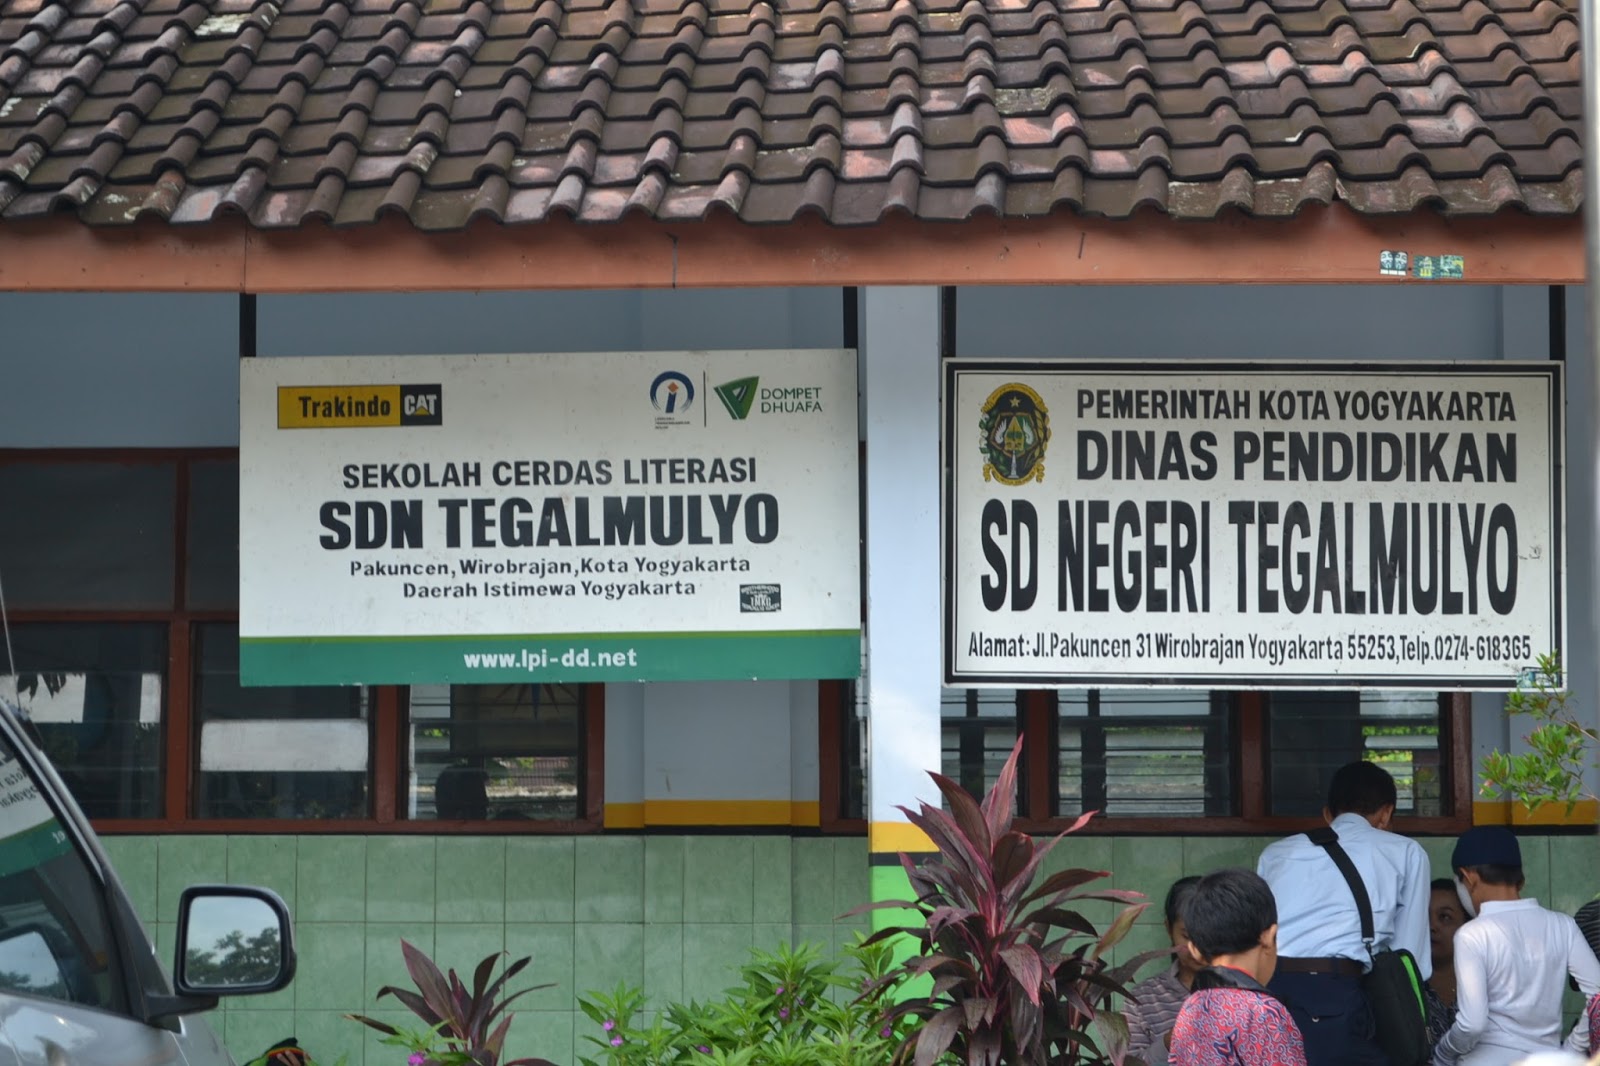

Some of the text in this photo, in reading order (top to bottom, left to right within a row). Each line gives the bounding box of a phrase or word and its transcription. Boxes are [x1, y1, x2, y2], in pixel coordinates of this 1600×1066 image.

[404, 394, 438, 416] CAT
[761, 387, 822, 400] DOMPET
[1077, 389, 1251, 419] PEMERINTAH
[1258, 390, 1330, 420] KOTA
[1334, 390, 1517, 421] YOGYAKARTA
[299, 395, 391, 418] Trakindo
[761, 400, 823, 414] DHUAFA
[1077, 429, 1217, 480] DINAS
[1233, 430, 1517, 483] PENDIDIKAN
[343, 457, 756, 489] SEKOLAH CERDAS LITERASI
[319, 493, 779, 550] SDN TEGALMULYO
[350, 560, 456, 579] Pakuncen,
[634, 556, 750, 577] Yogyakarta
[980, 498, 1516, 616] SD NEGERI TEGALMULYO
[403, 580, 696, 602] Daerah Istimewa Yogyakarta
[463, 648, 638, 672] www.lpi-dd.net
[1136, 633, 1151, 658] 31
[1154, 632, 1245, 665] Wirobrajan
[1248, 633, 1343, 666] Yogyakarta
